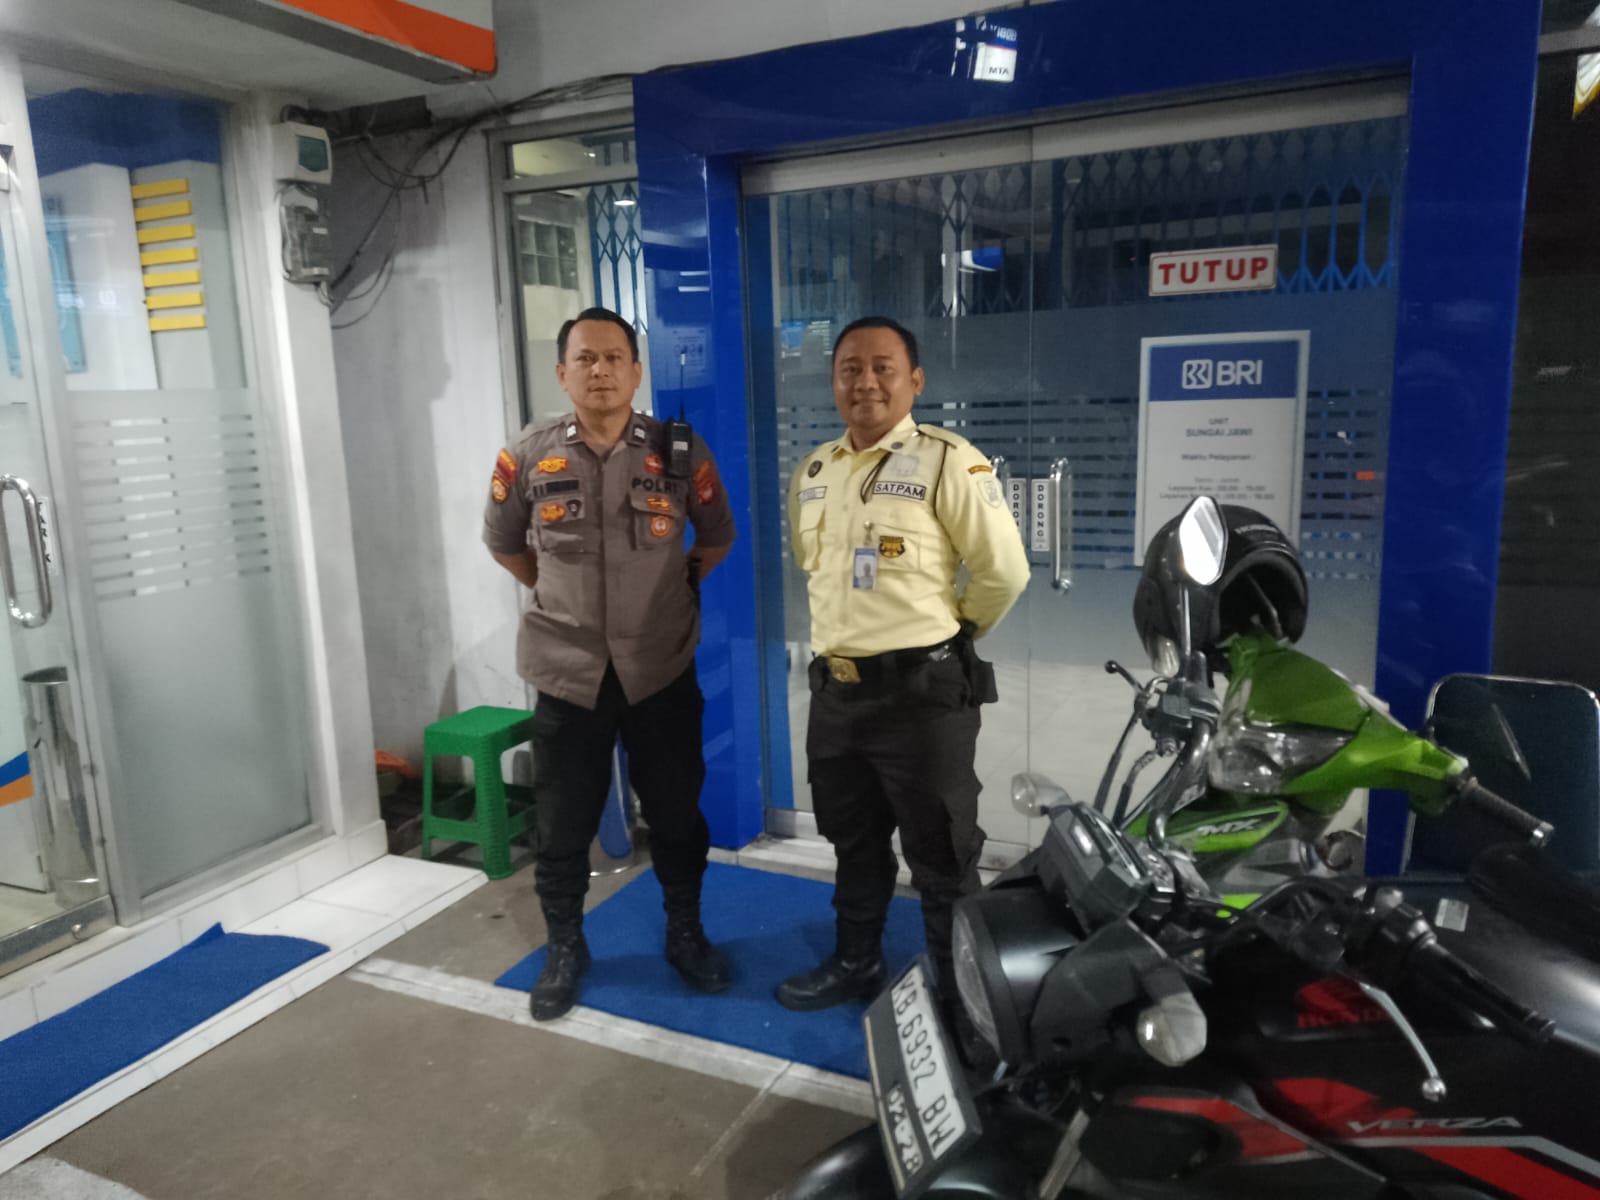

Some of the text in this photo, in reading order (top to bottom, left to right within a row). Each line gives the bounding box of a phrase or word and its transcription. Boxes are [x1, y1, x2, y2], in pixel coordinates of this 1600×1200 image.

[1158, 256, 1269, 286] TUTUP
[1216, 360, 1263, 386] BRI
[1186, 428, 1224, 437] SUNGAI
[632, 477, 678, 495] POLRI
[875, 483, 924, 498] SATPAM
[1012, 484, 1020, 527] DORO
[1037, 484, 1045, 537] DORONG
[37, 502, 51, 563] TARK
[894, 974, 956, 1148] KB 6932 BW
[1347, 1115, 1523, 1133] VERZA
